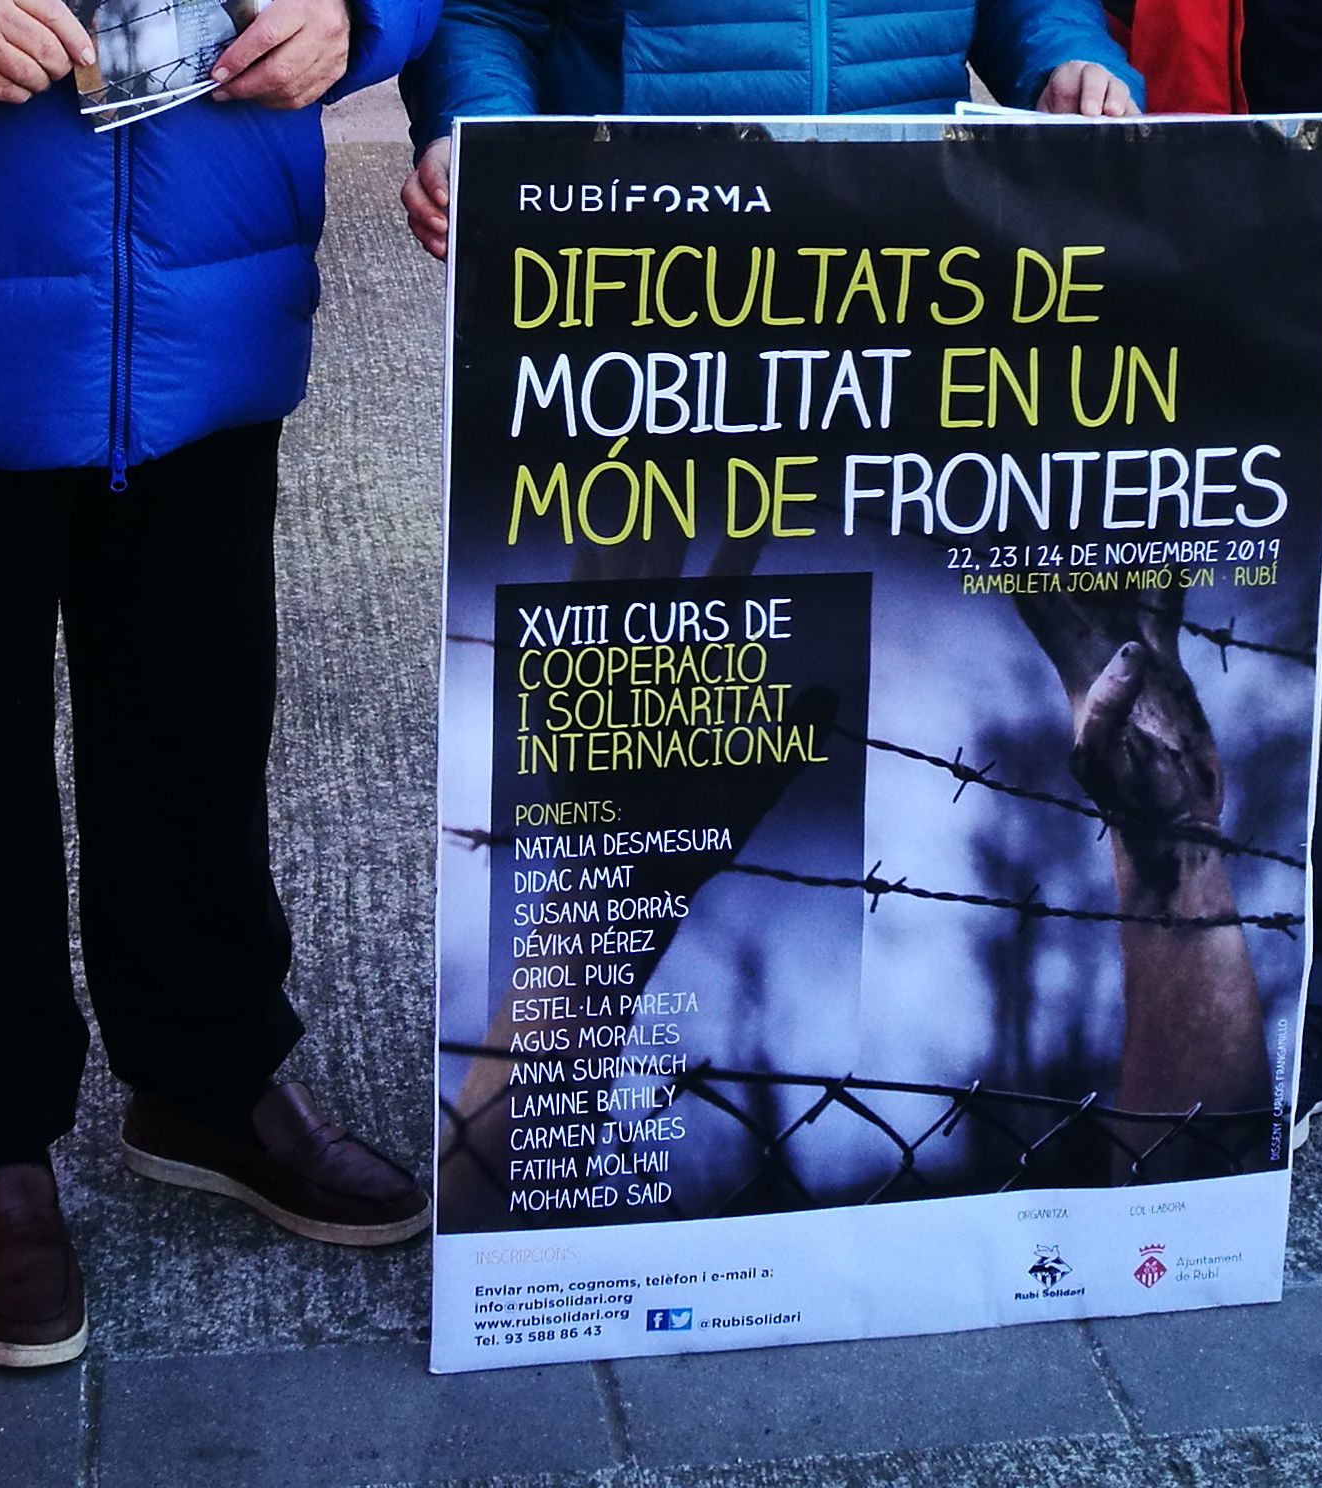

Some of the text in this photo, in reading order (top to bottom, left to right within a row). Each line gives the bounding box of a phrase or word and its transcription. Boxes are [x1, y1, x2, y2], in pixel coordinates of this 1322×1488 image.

[519, 179, 772, 213] RUBÍFORMA
[513, 245, 1106, 328] DIFICULTATS DE
[510, 345, 1179, 439] MOBILITAT EN UN
[507, 436, 1289, 546] MÓN DE FRONTERES
[947, 548, 980, 571] 22,
[989, 546, 1018, 567] 23
[1038, 546, 1064, 567] 24
[1070, 543, 1098, 566] DE
[1105, 540, 1219, 566] NOVEMBRE
[1226, 538, 1281, 560] 2019
[962, 560, 1279, 595] RAMBLETA JOAN MIRÓ S/N RUBÍ
[519, 598, 792, 648] XVIII CURS DE
[518, 633, 768, 690] COOPERACIÓ
[518, 684, 792, 732] I SOLIDARITAT
[517, 724, 829, 775] INTERNACIONAL
[515, 800, 622, 827] PONENTS:
[515, 828, 733, 861] NATALIA DESMESURA
[514, 865, 634, 894] DIDAC AMAT
[513, 890, 689, 926] SUSANA BORRÀS
[513, 925, 656, 959] DÉVIKA PÉREZ
[512, 963, 634, 991] ORIOL PUIG
[619, 992, 699, 1016] PAREJA
[510, 1023, 680, 1053] AGUS MORALES
[509, 1053, 687, 1086] ANNA SURINYACH
[511, 1084, 676, 1119] LAMINE BATHILY
[1273, 1083, 1285, 1117] CARLOS
[510, 1117, 686, 1151] CARMEN JUARES
[510, 1157, 578, 1181] FATIHA
[510, 1182, 672, 1212] MOHAMED SAID
[1017, 1208, 1068, 1221] ORGANITZA
[475, 1245, 578, 1265] INSCRIPCIONS
[1176, 1252, 1243, 1269] Ajuntament
[475, 1284, 523, 1297] Enviar
[527, 1282, 564, 1294] nom,
[569, 1278, 641, 1292] cognoms,
[646, 1272, 698, 1287] telèfon
[702, 1271, 706, 1282] i
[711, 1267, 756, 1282] e-mail
[1175, 1271, 1190, 1282] de
[474, 1293, 633, 1313] info@rubisolidari.org
[1042, 1287, 1085, 1298] Solidari
[474, 1309, 630, 1330] www.rubisolidari.org
[697, 1311, 801, 1331] @RubiSolidari
[474, 1325, 602, 1347] Tel. 93 588 86 43
